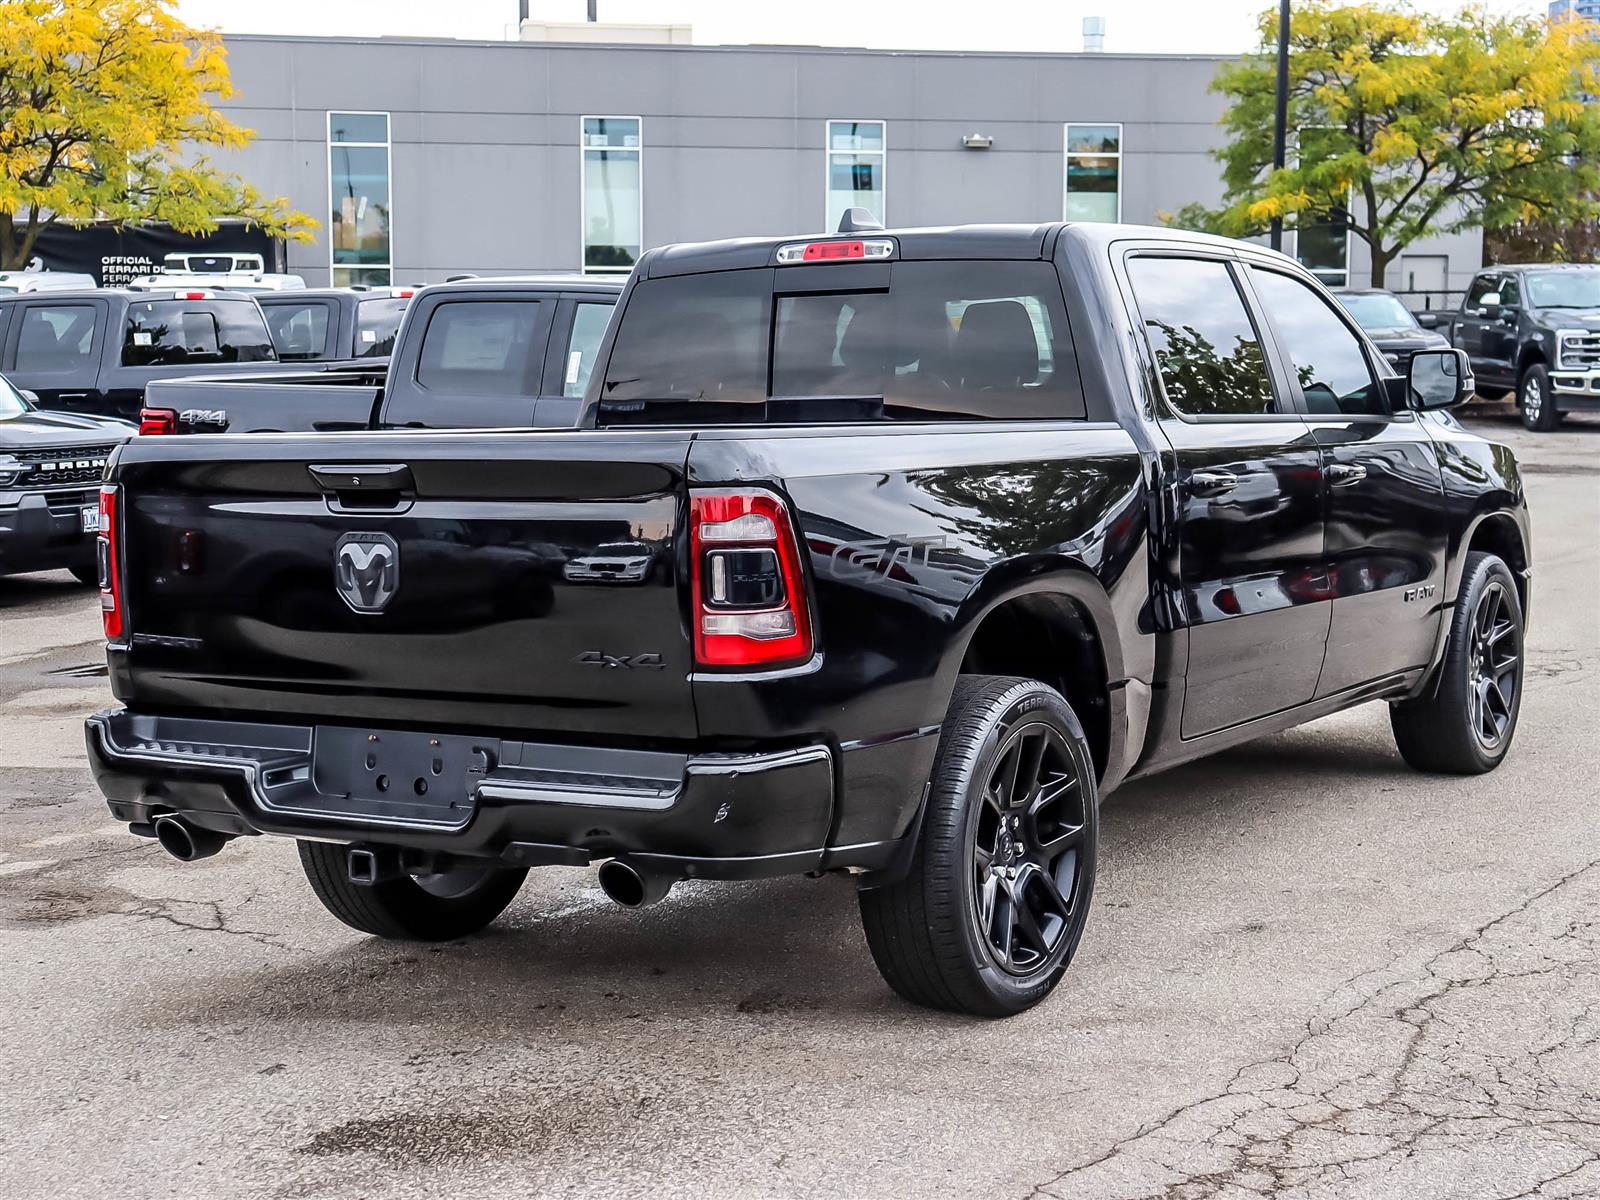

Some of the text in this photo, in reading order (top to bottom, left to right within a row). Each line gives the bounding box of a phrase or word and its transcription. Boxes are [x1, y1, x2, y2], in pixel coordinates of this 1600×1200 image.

[101, 256, 153, 265] OFFICIAL
[102, 265, 166, 274] FERRARI DE
[102, 274, 138, 283] FERRA
[41, 460, 105, 471] BRON
[83, 512, 99, 527] DJK
[1404, 584, 1436, 602] RAM
